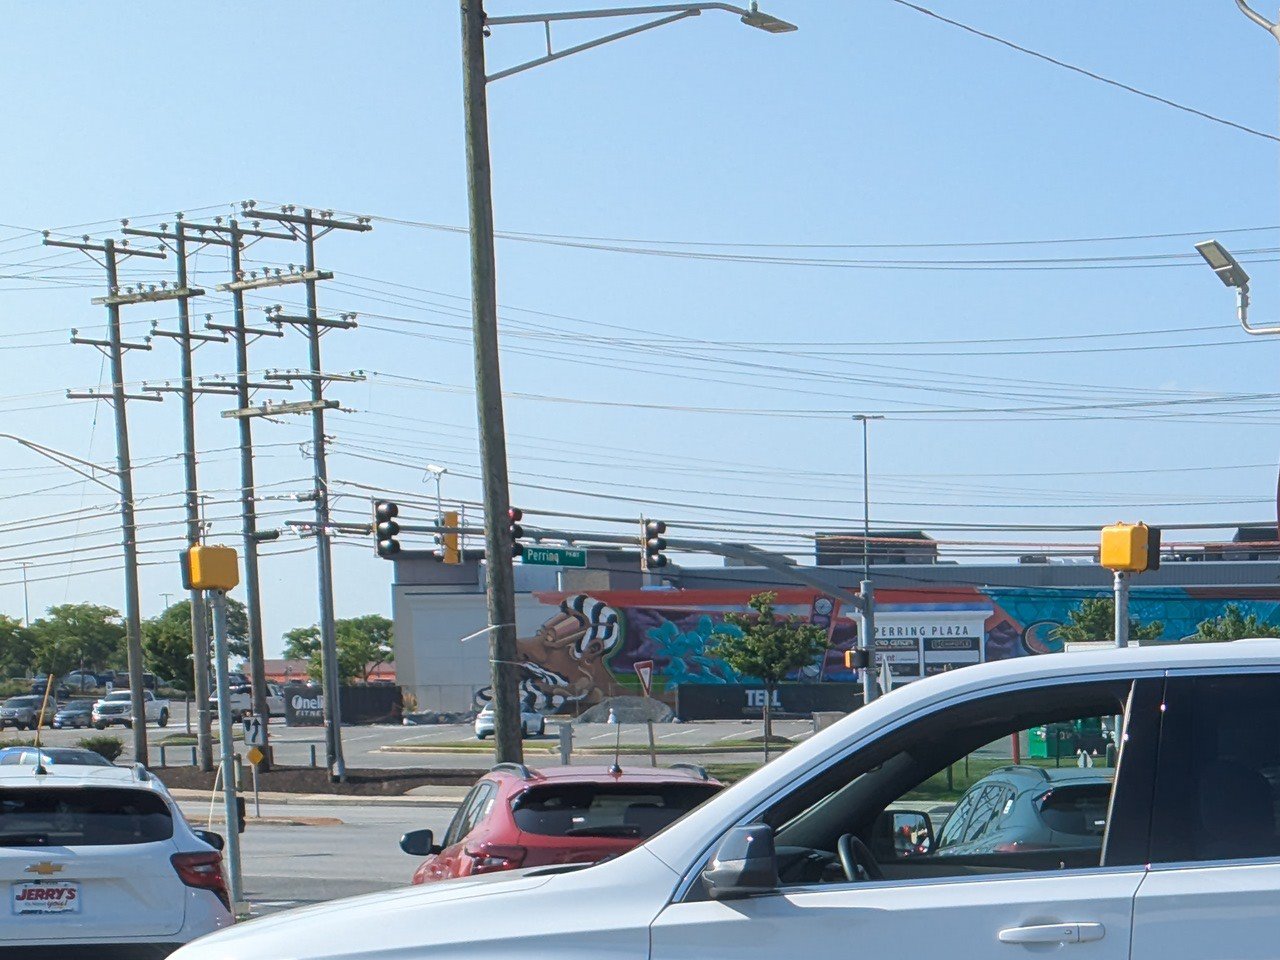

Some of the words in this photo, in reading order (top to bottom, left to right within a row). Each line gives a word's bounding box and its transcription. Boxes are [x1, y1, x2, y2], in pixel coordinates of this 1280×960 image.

[527, 549, 559, 564] Perring
[874, 626, 926, 636] PERRING
[931, 625, 969, 636] PLAZA
[16, 888, 76, 900] JERRY'S
